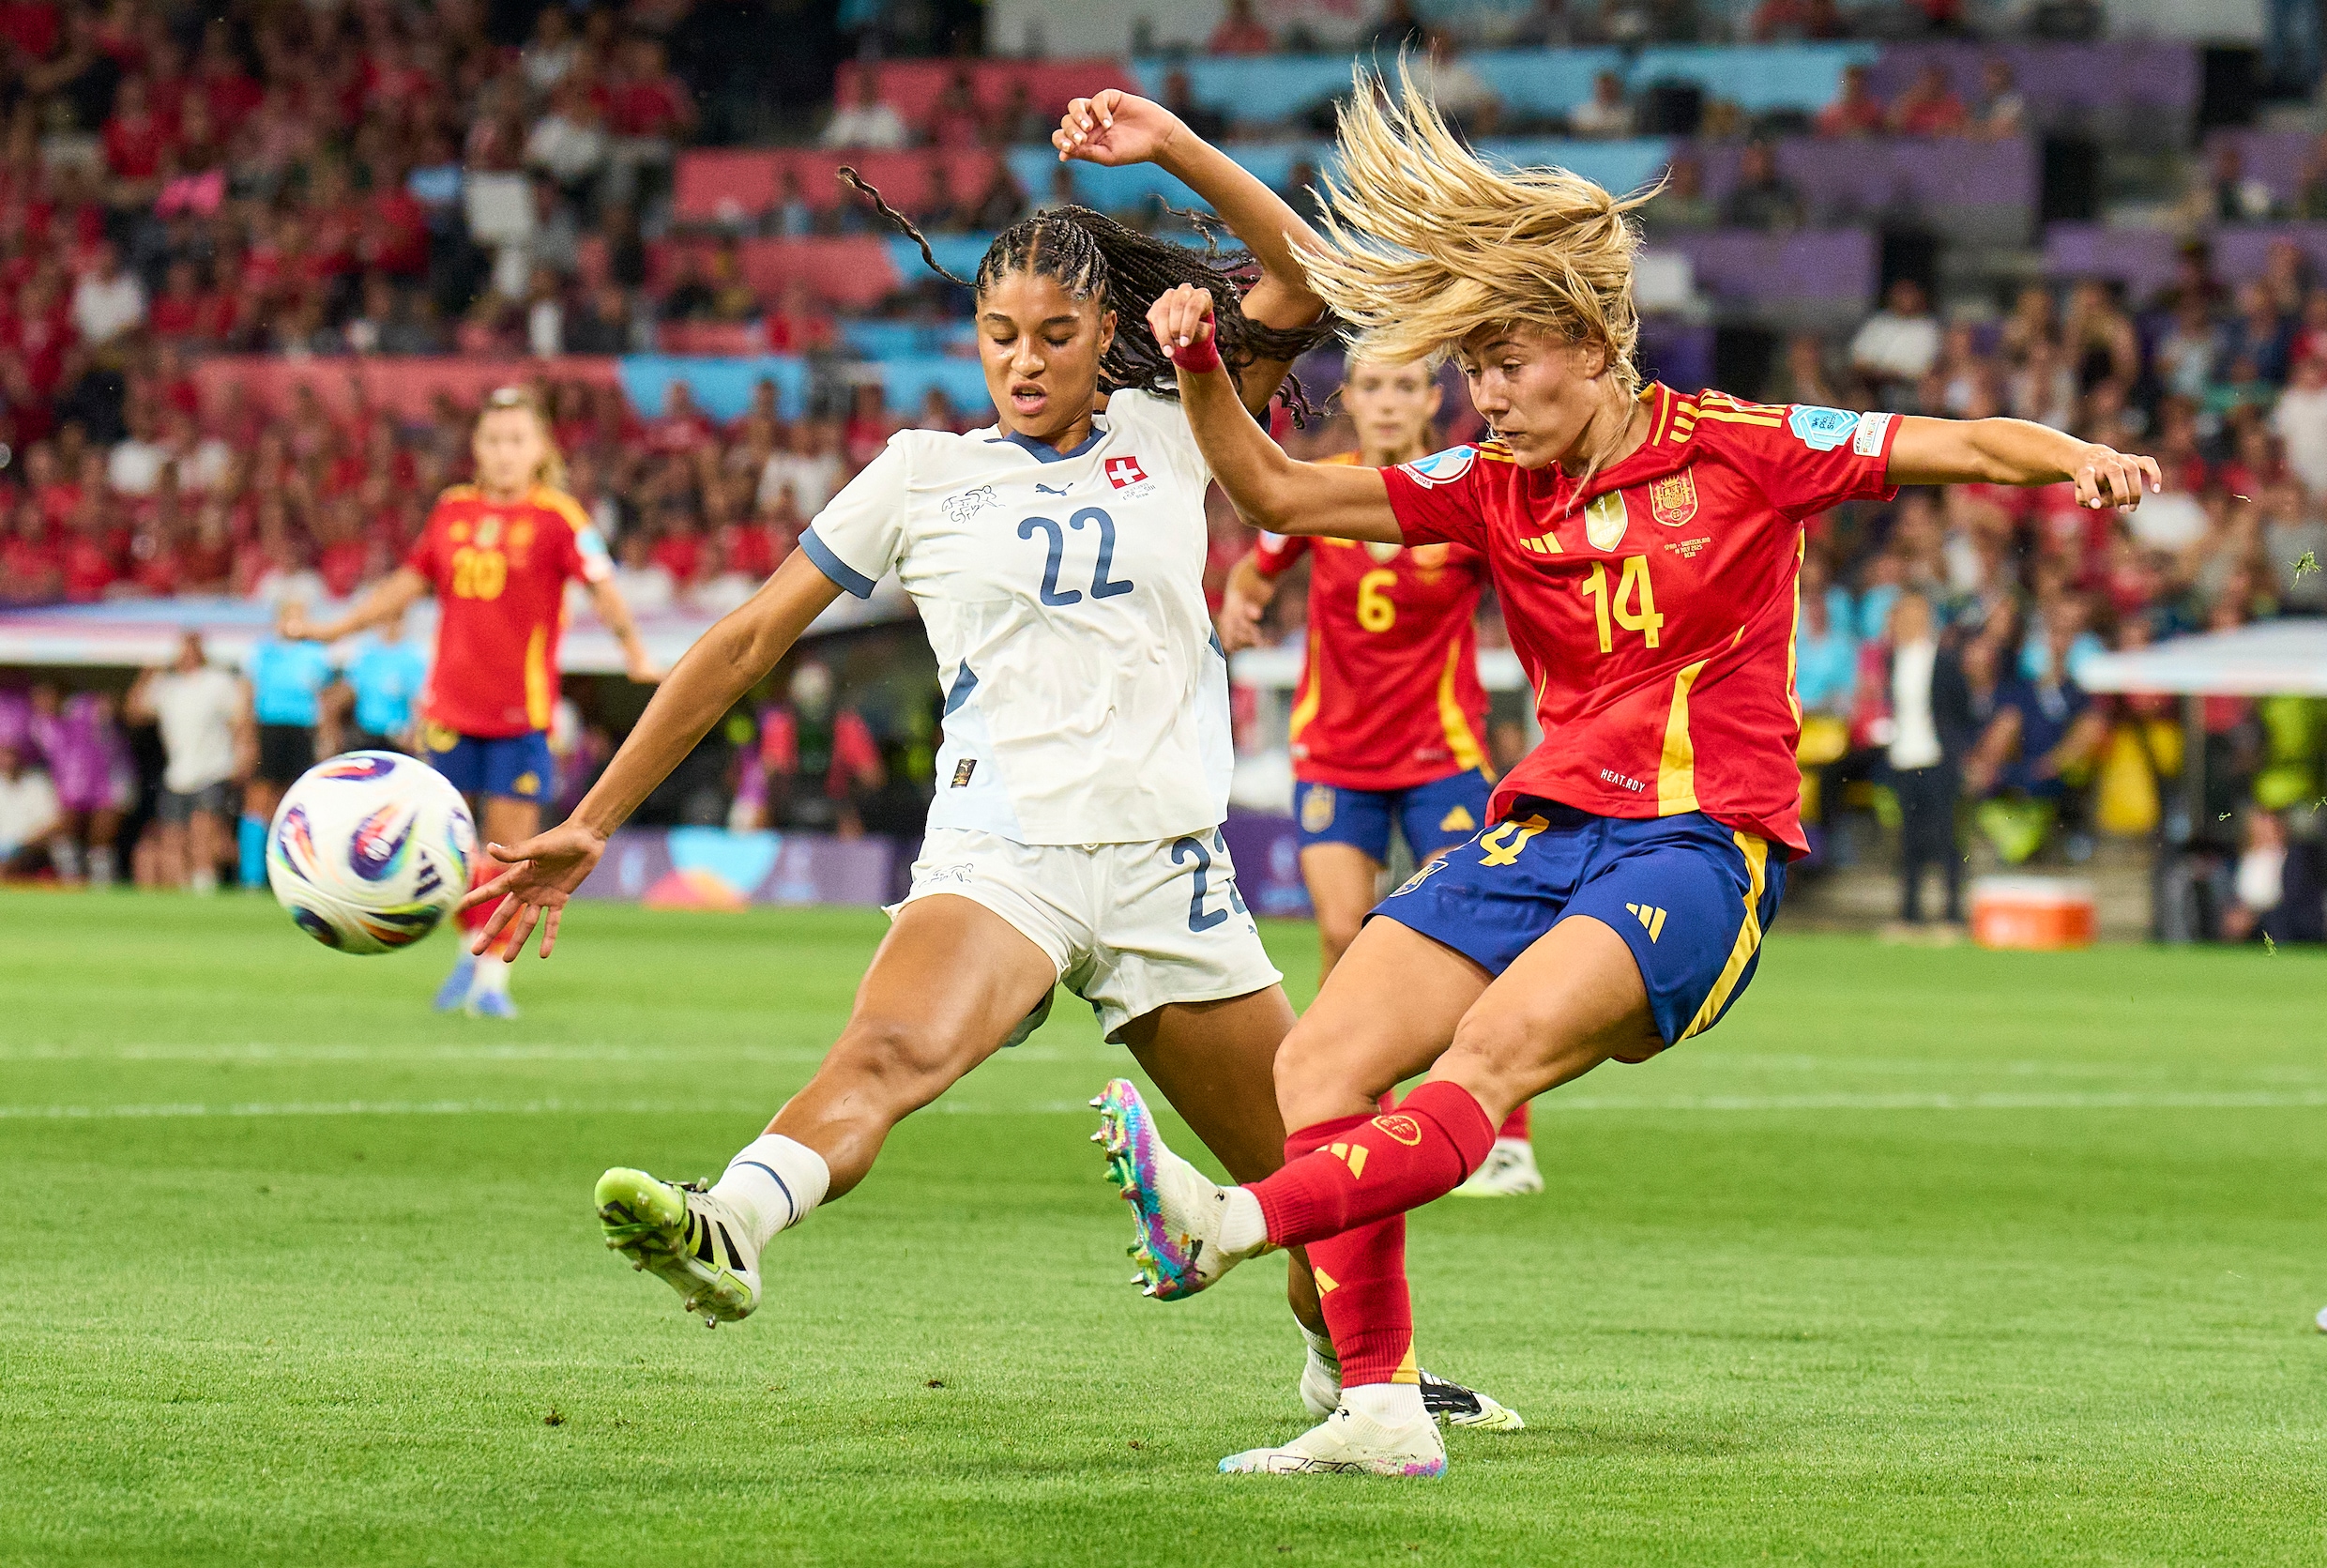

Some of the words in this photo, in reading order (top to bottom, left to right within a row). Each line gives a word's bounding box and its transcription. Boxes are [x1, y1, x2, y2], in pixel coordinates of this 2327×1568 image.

[452, 546, 508, 601] 20
[1017, 507, 1133, 606] 22
[1356, 568, 1399, 633] 6
[1582, 555, 1664, 654] 14
[1600, 768, 1646, 794] HEAT.RDY
